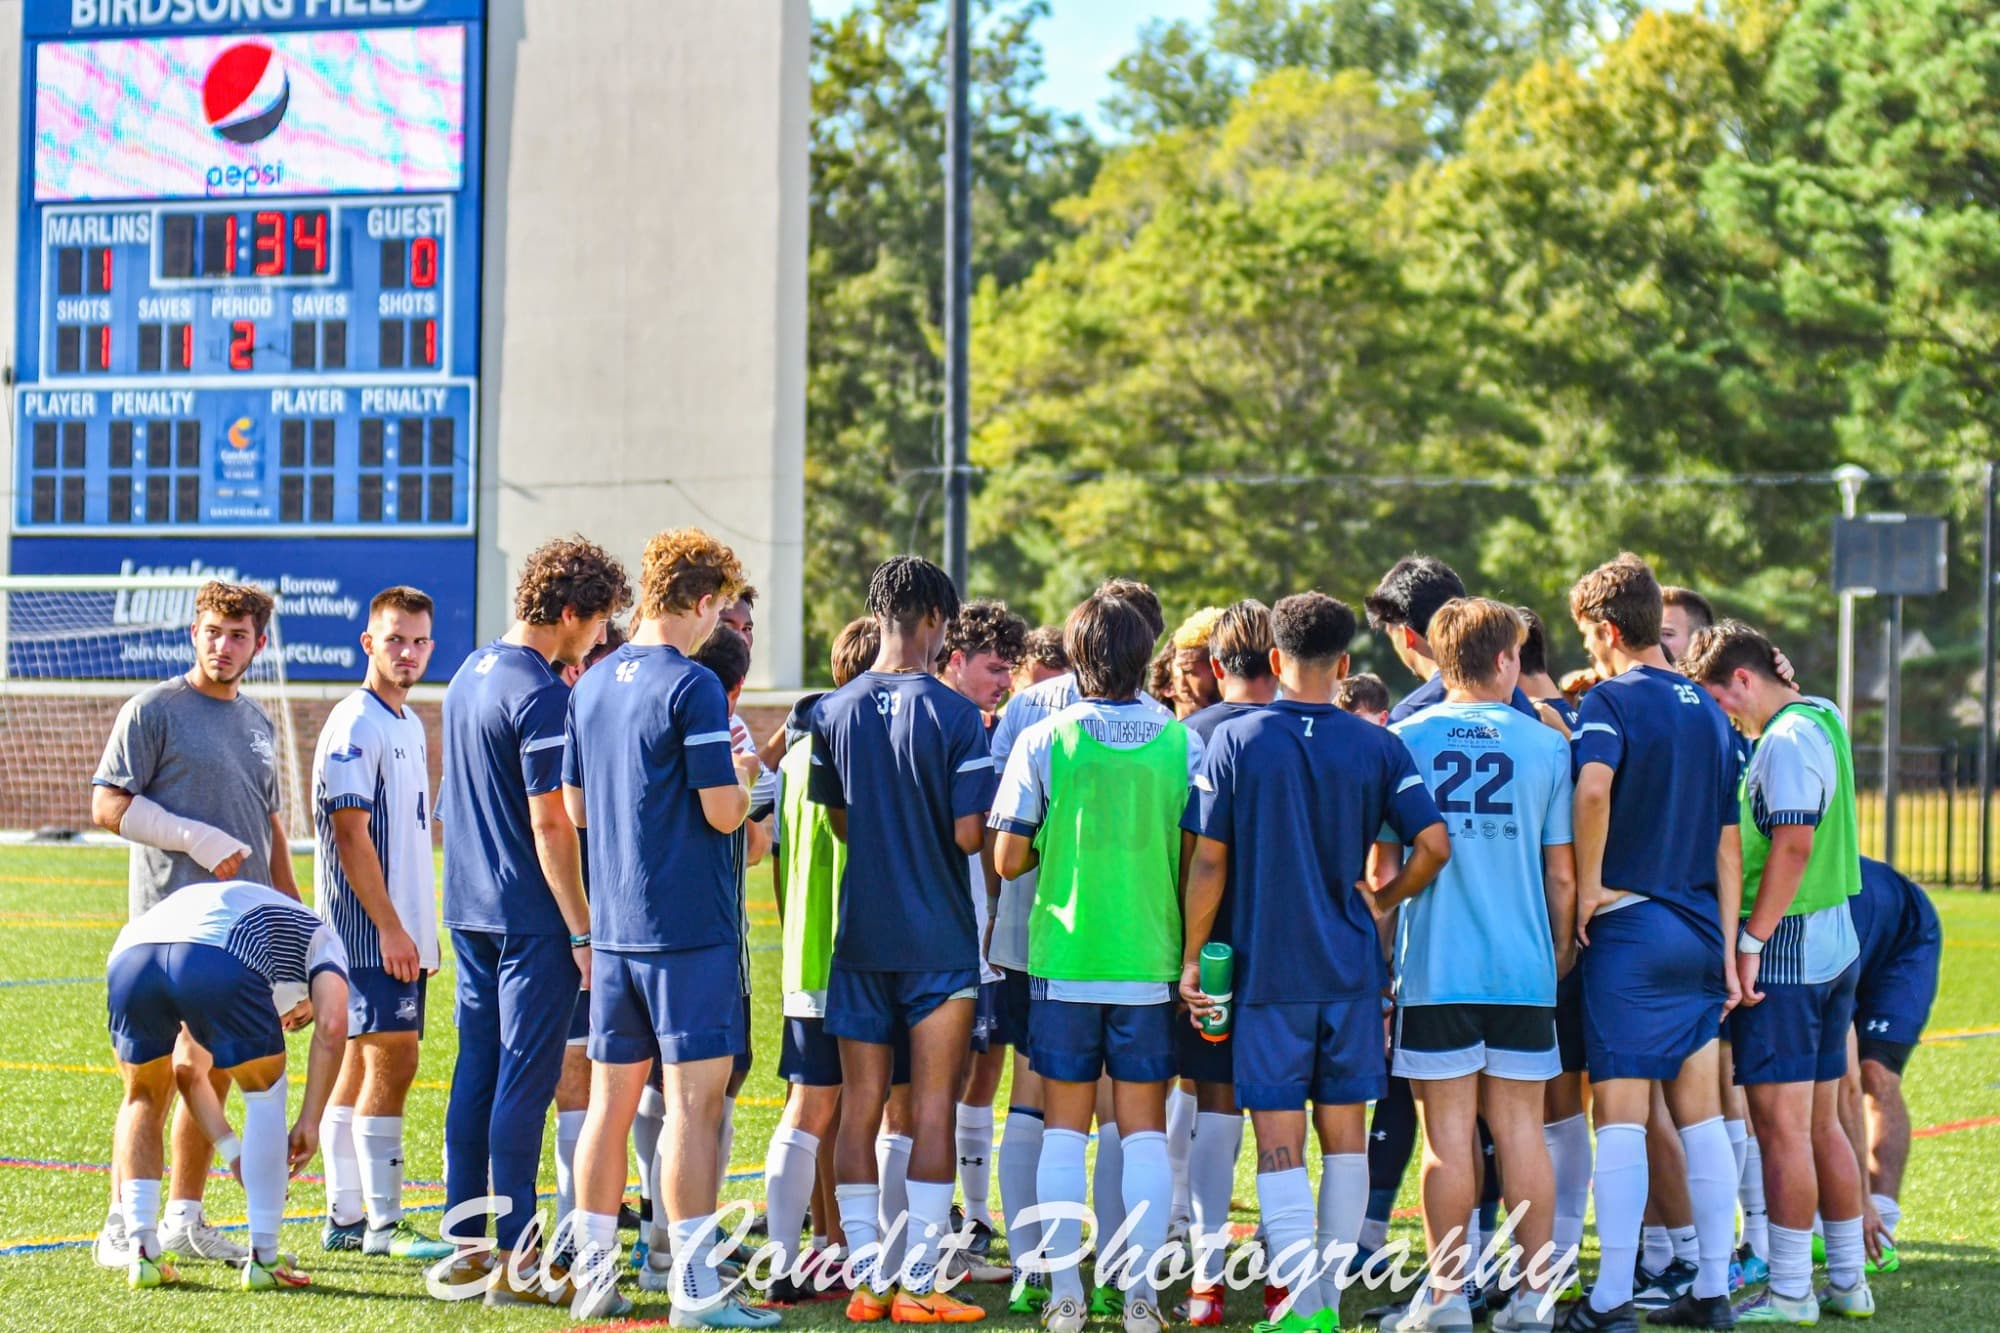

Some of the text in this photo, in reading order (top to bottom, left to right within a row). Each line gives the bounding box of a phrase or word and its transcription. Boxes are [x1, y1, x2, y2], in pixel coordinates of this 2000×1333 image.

[206, 160, 283, 197] pepsi
[48, 214, 151, 244] MARLINS
[367, 206, 445, 238] GUEST
[224, 211, 327, 276] 1:34
[102, 248, 112, 291] 1
[411, 237, 437, 287] 0
[57, 300, 110, 321] SHOTS
[138, 297, 191, 319] SAVES
[211, 297, 272, 318] PERIOD
[292, 295, 347, 317] SAVES
[379, 293, 435, 315] SHOTS
[229, 320, 255, 370] 2
[25, 391, 194, 417] PLAYER PENALTY
[271, 387, 446, 414] PLAYER PENALTY
[281, 574, 337, 594] Borrow
[308, 596, 357, 620] Wisely
[156, 643, 197, 662] toda
[877, 691, 901, 716] 33
[1673, 683, 1700, 705] 25
[1301, 716, 1313, 737] 7
[1447, 727, 1475, 739] JCA
[1433, 750, 1514, 815] 22
[416, 791, 426, 830] 4
